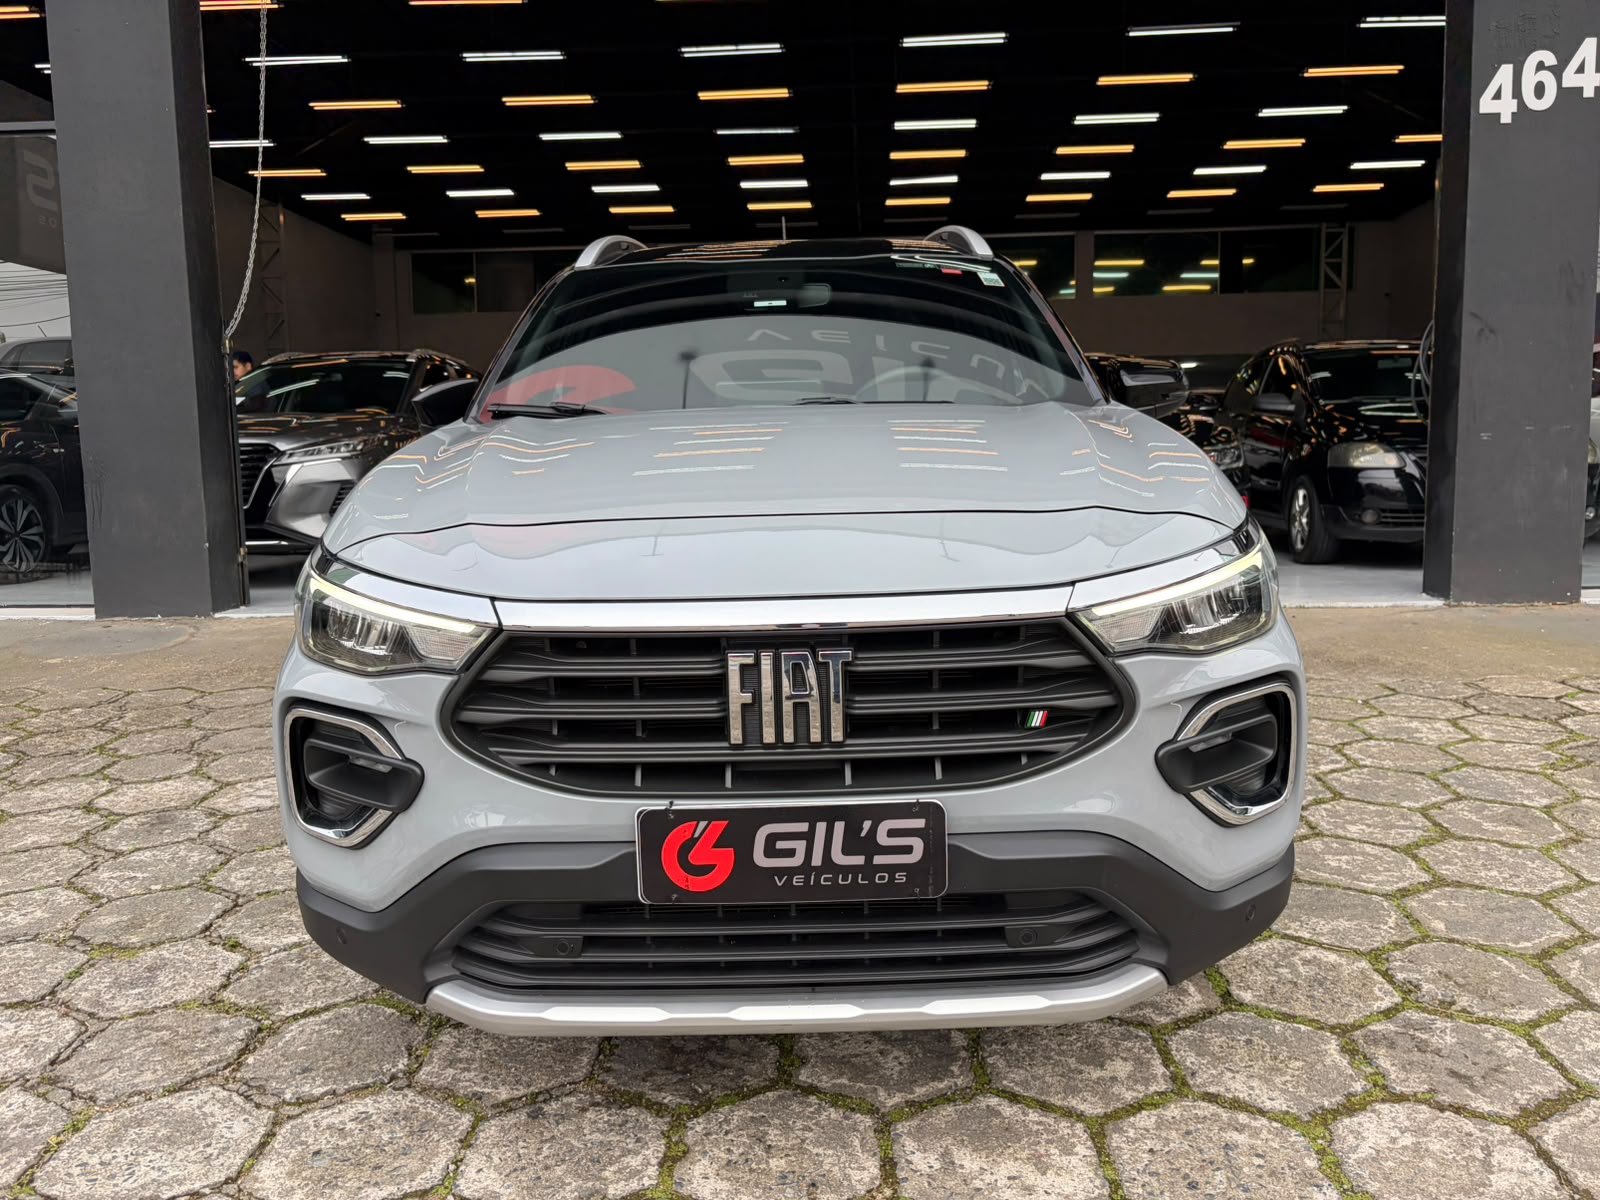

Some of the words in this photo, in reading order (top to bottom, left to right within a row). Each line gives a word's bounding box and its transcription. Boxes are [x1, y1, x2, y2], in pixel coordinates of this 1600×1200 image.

[1479, 37, 1600, 124] 464
[726, 648, 855, 746] FIAT
[753, 818, 926, 868] GIL'S
[773, 871, 908, 887] VEÍCULOS
